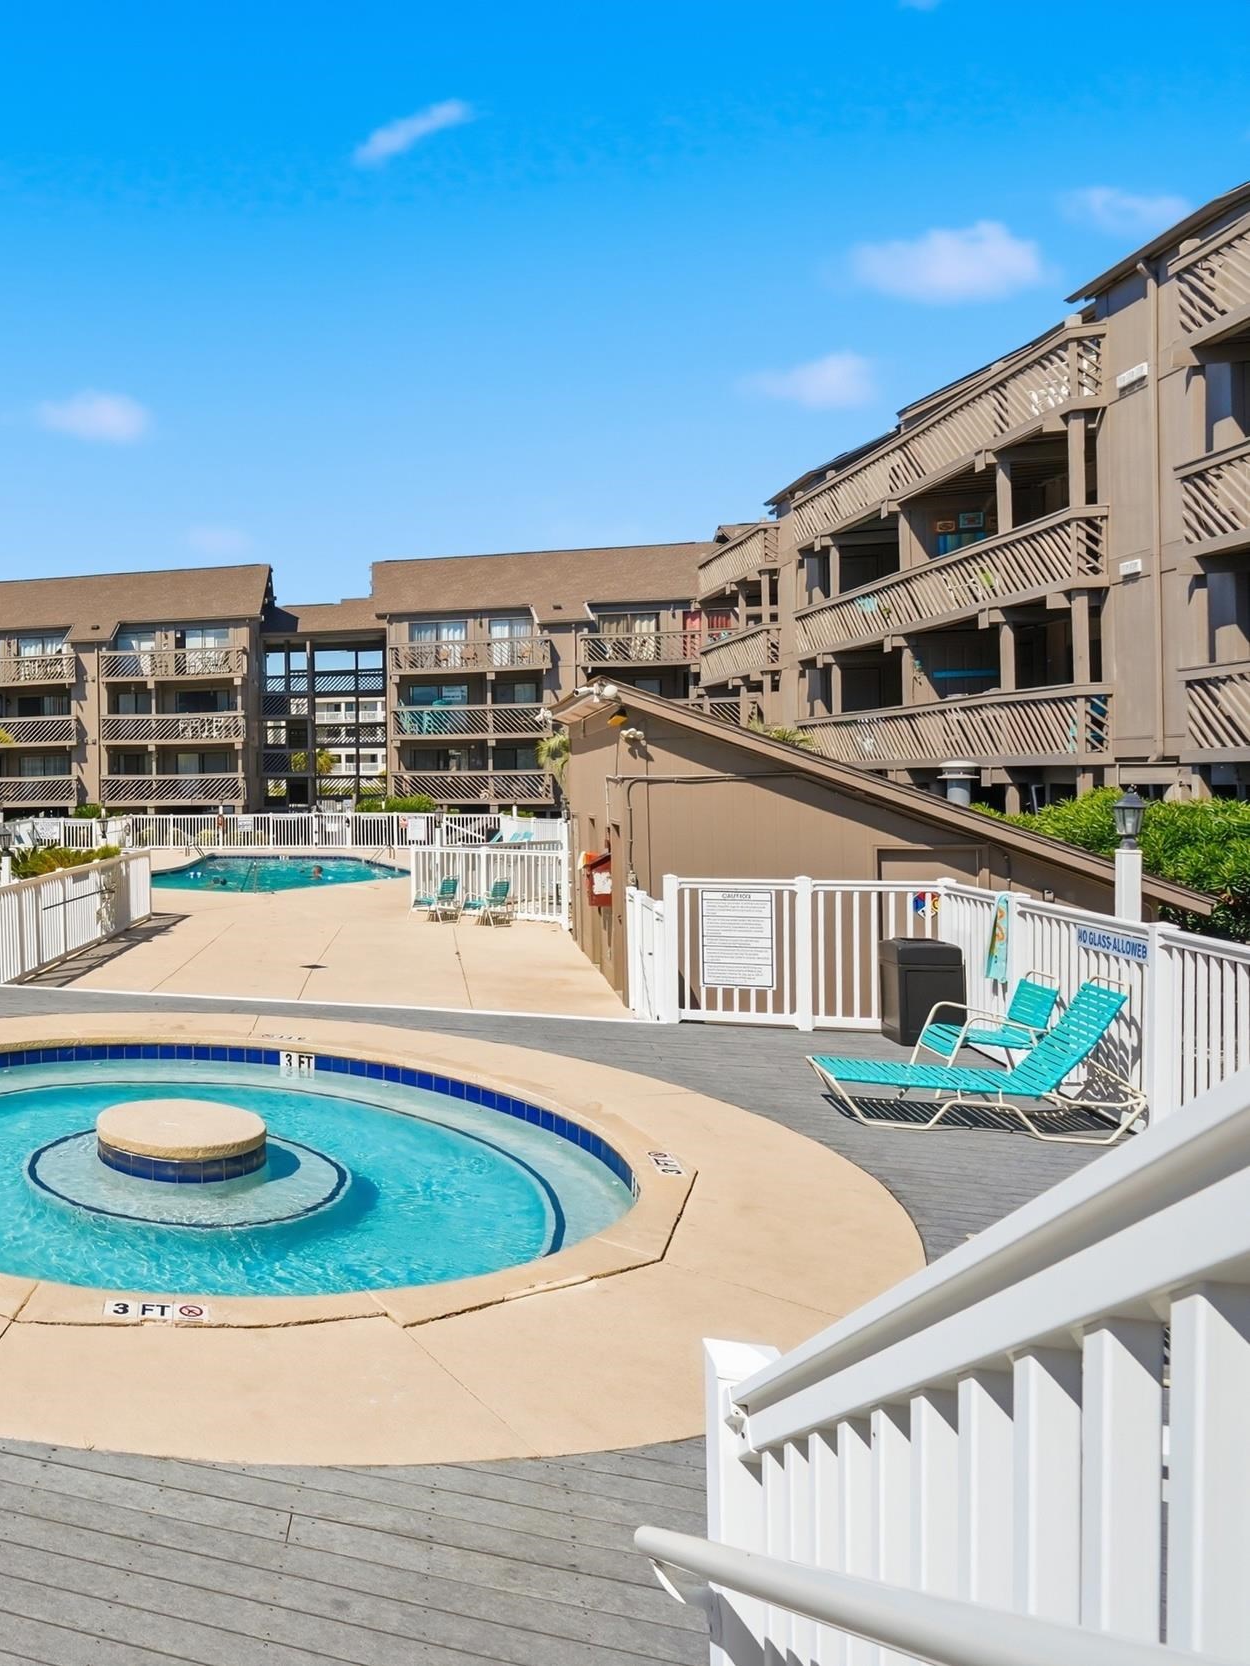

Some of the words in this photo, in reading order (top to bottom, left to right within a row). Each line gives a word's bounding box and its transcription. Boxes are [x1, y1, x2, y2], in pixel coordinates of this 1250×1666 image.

[1089, 931, 1111, 950] GLASS
[285, 1053, 293, 1067] 3
[298, 1054, 314, 1069] FT
[113, 1302, 130, 1315] 3
[141, 1303, 171, 1317] FT
